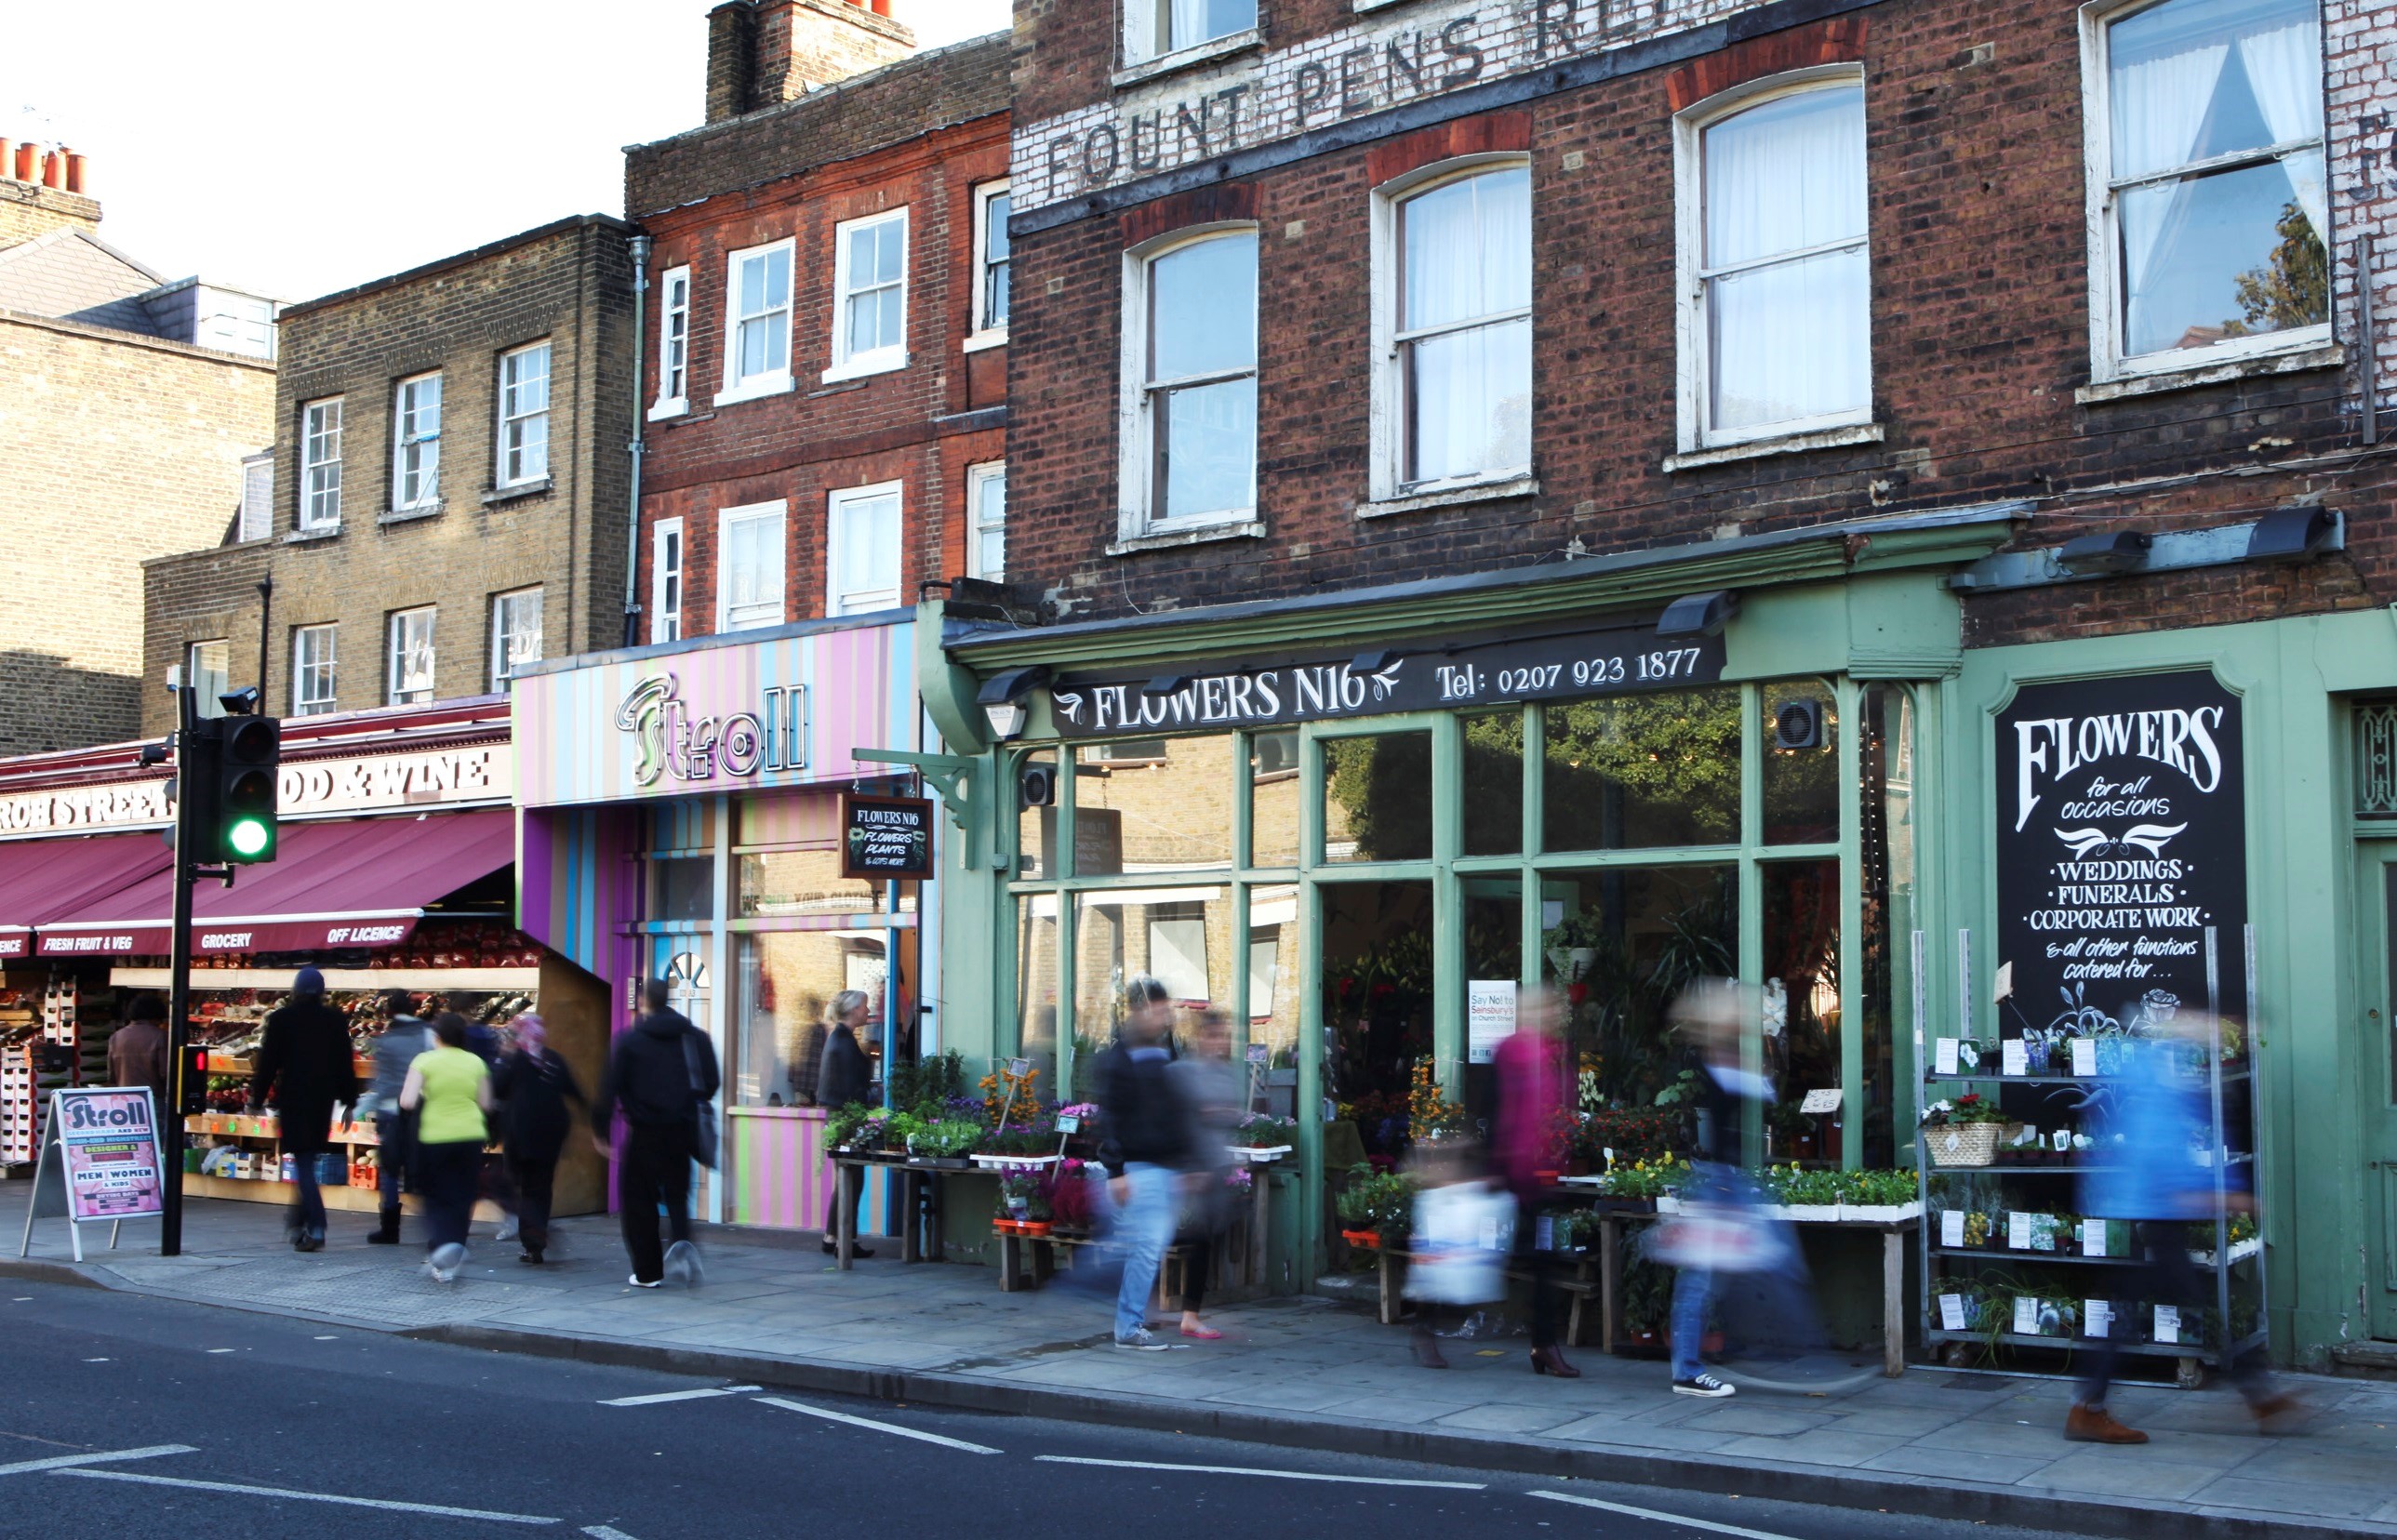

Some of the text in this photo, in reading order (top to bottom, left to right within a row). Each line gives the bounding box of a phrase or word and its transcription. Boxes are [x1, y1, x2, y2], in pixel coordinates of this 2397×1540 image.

[1047, 83, 1249, 198] FOUNT
[1295, 16, 1484, 126] PENS
[1435, 646, 1701, 700] Tel: 0207 923 1877
[1091, 663, 1365, 730] FLOWERS N16
[614, 670, 808, 787] Stroll
[340, 764, 372, 799] &
[372, 751, 489, 796] WINE
[2013, 705, 2224, 833] FLOWERS
[2086, 776, 2152, 798] for all
[56, 785, 171, 825] STREET
[2060, 796, 2170, 819] occasions
[857, 809, 919, 826] FLOWERS N16
[863, 830, 912, 843] FLOWERS
[864, 843, 906, 855] PLANTS
[872, 856, 888, 866] LOTS
[887, 857, 907, 867] MORE
[2057, 858, 2183, 882] WEDDINGS
[2057, 883, 2175, 905] FUNERALS
[2030, 906, 2203, 930] CORPORATE WORK
[44, 936, 133, 950] FRESH FRUIT & VEG
[201, 933, 252, 949] GROCERY
[326, 925, 405, 944] OFF LICENCE
[2046, 935, 2199, 959] & all other functions
[2062, 958, 2126, 980] catered
[1471, 995, 1514, 1005] Say No! to
[1471, 1005, 1514, 1016] Sainsbury's
[63, 1096, 146, 1129] Stroll
[77, 1168, 153, 1181] MEN WOMEN
